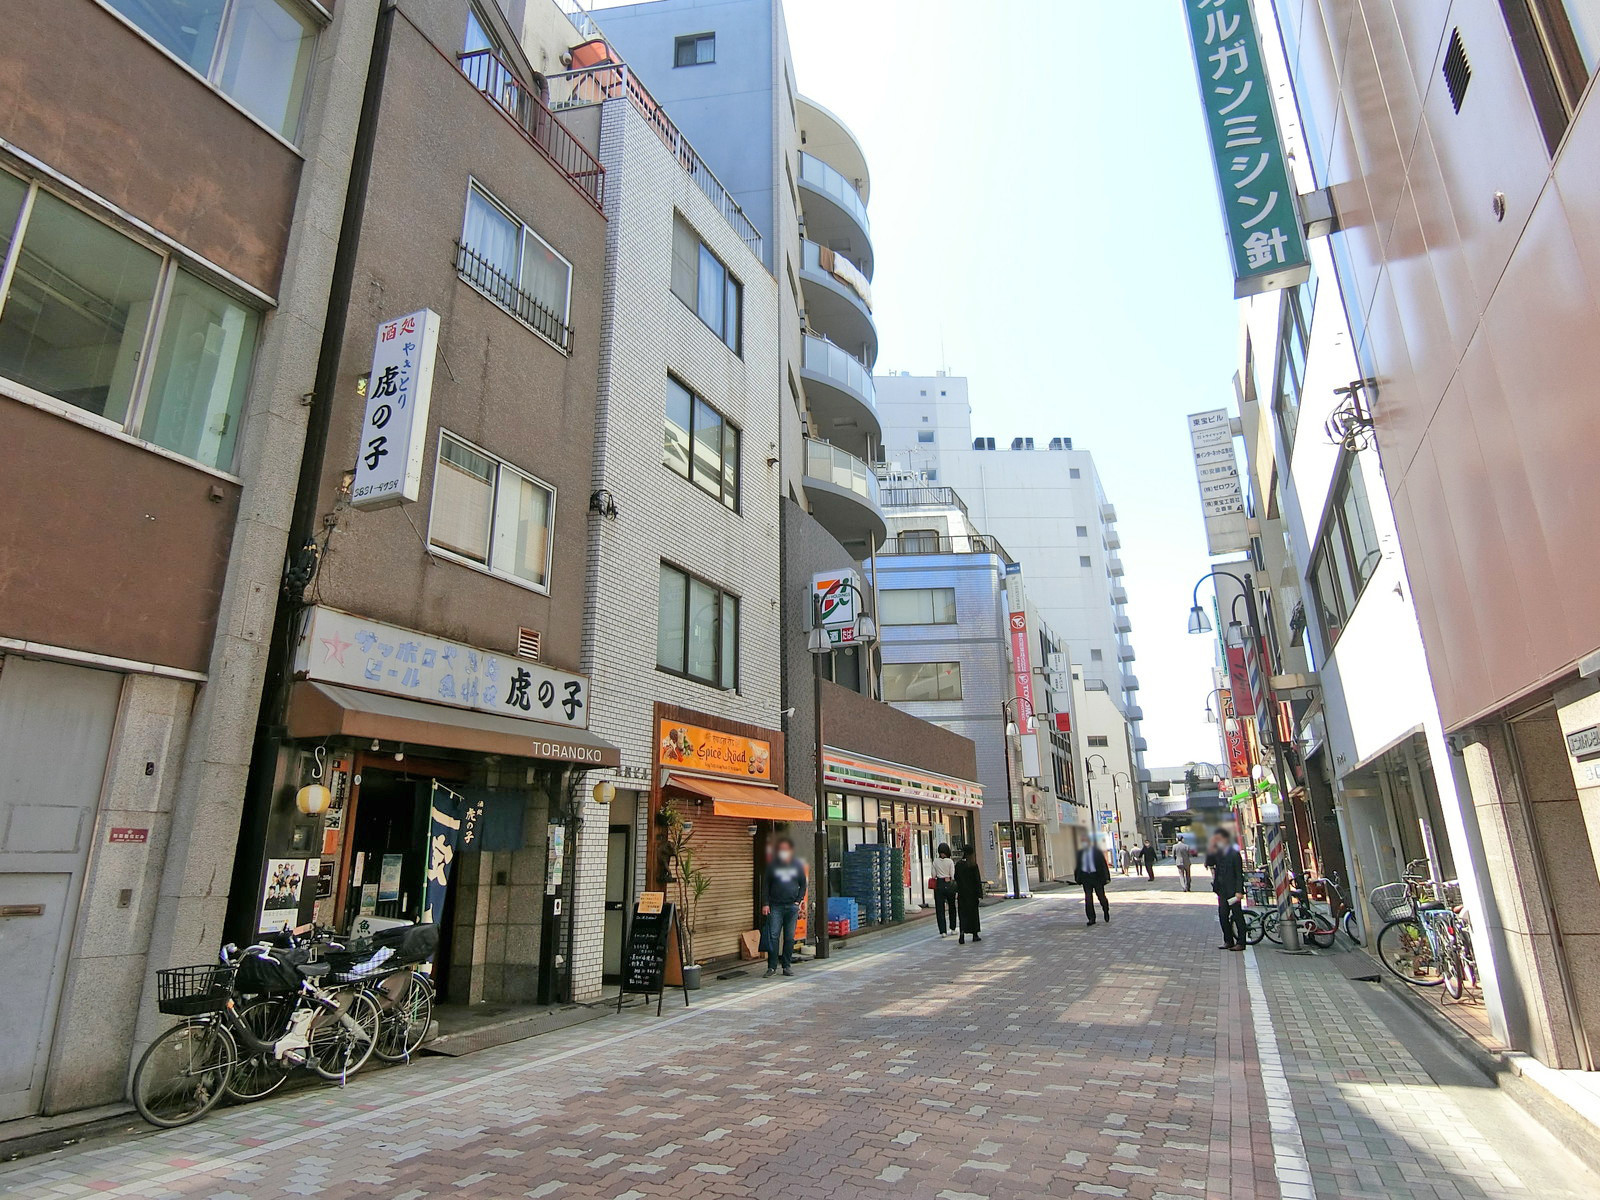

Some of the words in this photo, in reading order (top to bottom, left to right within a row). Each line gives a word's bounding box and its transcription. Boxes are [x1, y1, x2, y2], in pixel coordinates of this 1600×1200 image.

[1198, 0, 1288, 270] ルガンミシン針
[381, 317, 415, 343] 酒処
[398, 342, 416, 410] やきとり
[364, 365, 399, 471] 虎の子
[1193, 415, 1224, 427] 東宝ビル
[364, 657, 421, 688] ビール
[505, 666, 583, 720] 虎の子
[533, 741, 602, 762] TORANOKO
[697, 742, 722, 761] Spice
[723, 747, 747, 765] Road
[464, 807, 477, 844] 虎の子
